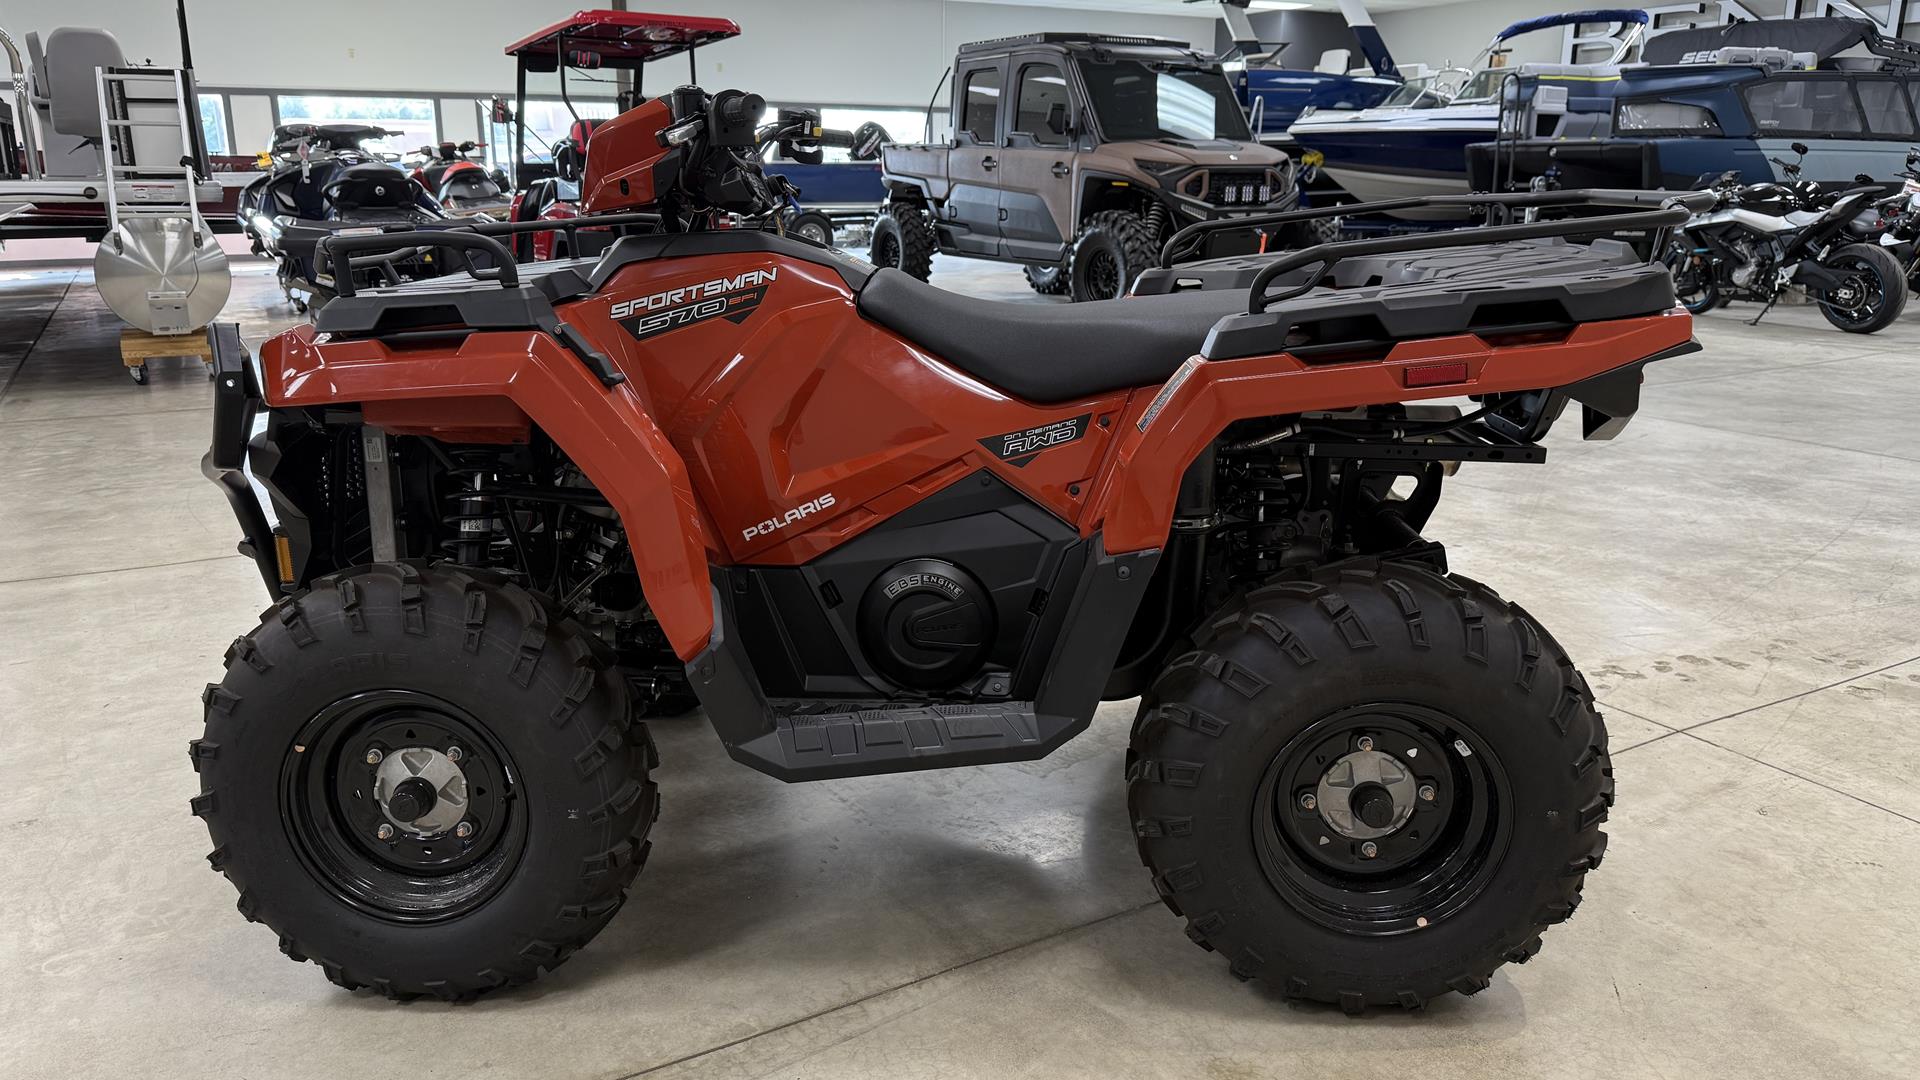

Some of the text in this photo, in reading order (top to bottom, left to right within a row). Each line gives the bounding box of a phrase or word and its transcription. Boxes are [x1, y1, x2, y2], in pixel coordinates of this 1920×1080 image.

[611, 267, 777, 318] SPORTSMAN
[638, 293, 758, 334] 570 EFI
[1003, 426, 1076, 456] AWD
[1026, 419, 1077, 436] DEMAND
[742, 492, 836, 541] POLARIS
[887, 575, 920, 595] EBS
[922, 575, 961, 596] ENGINE
